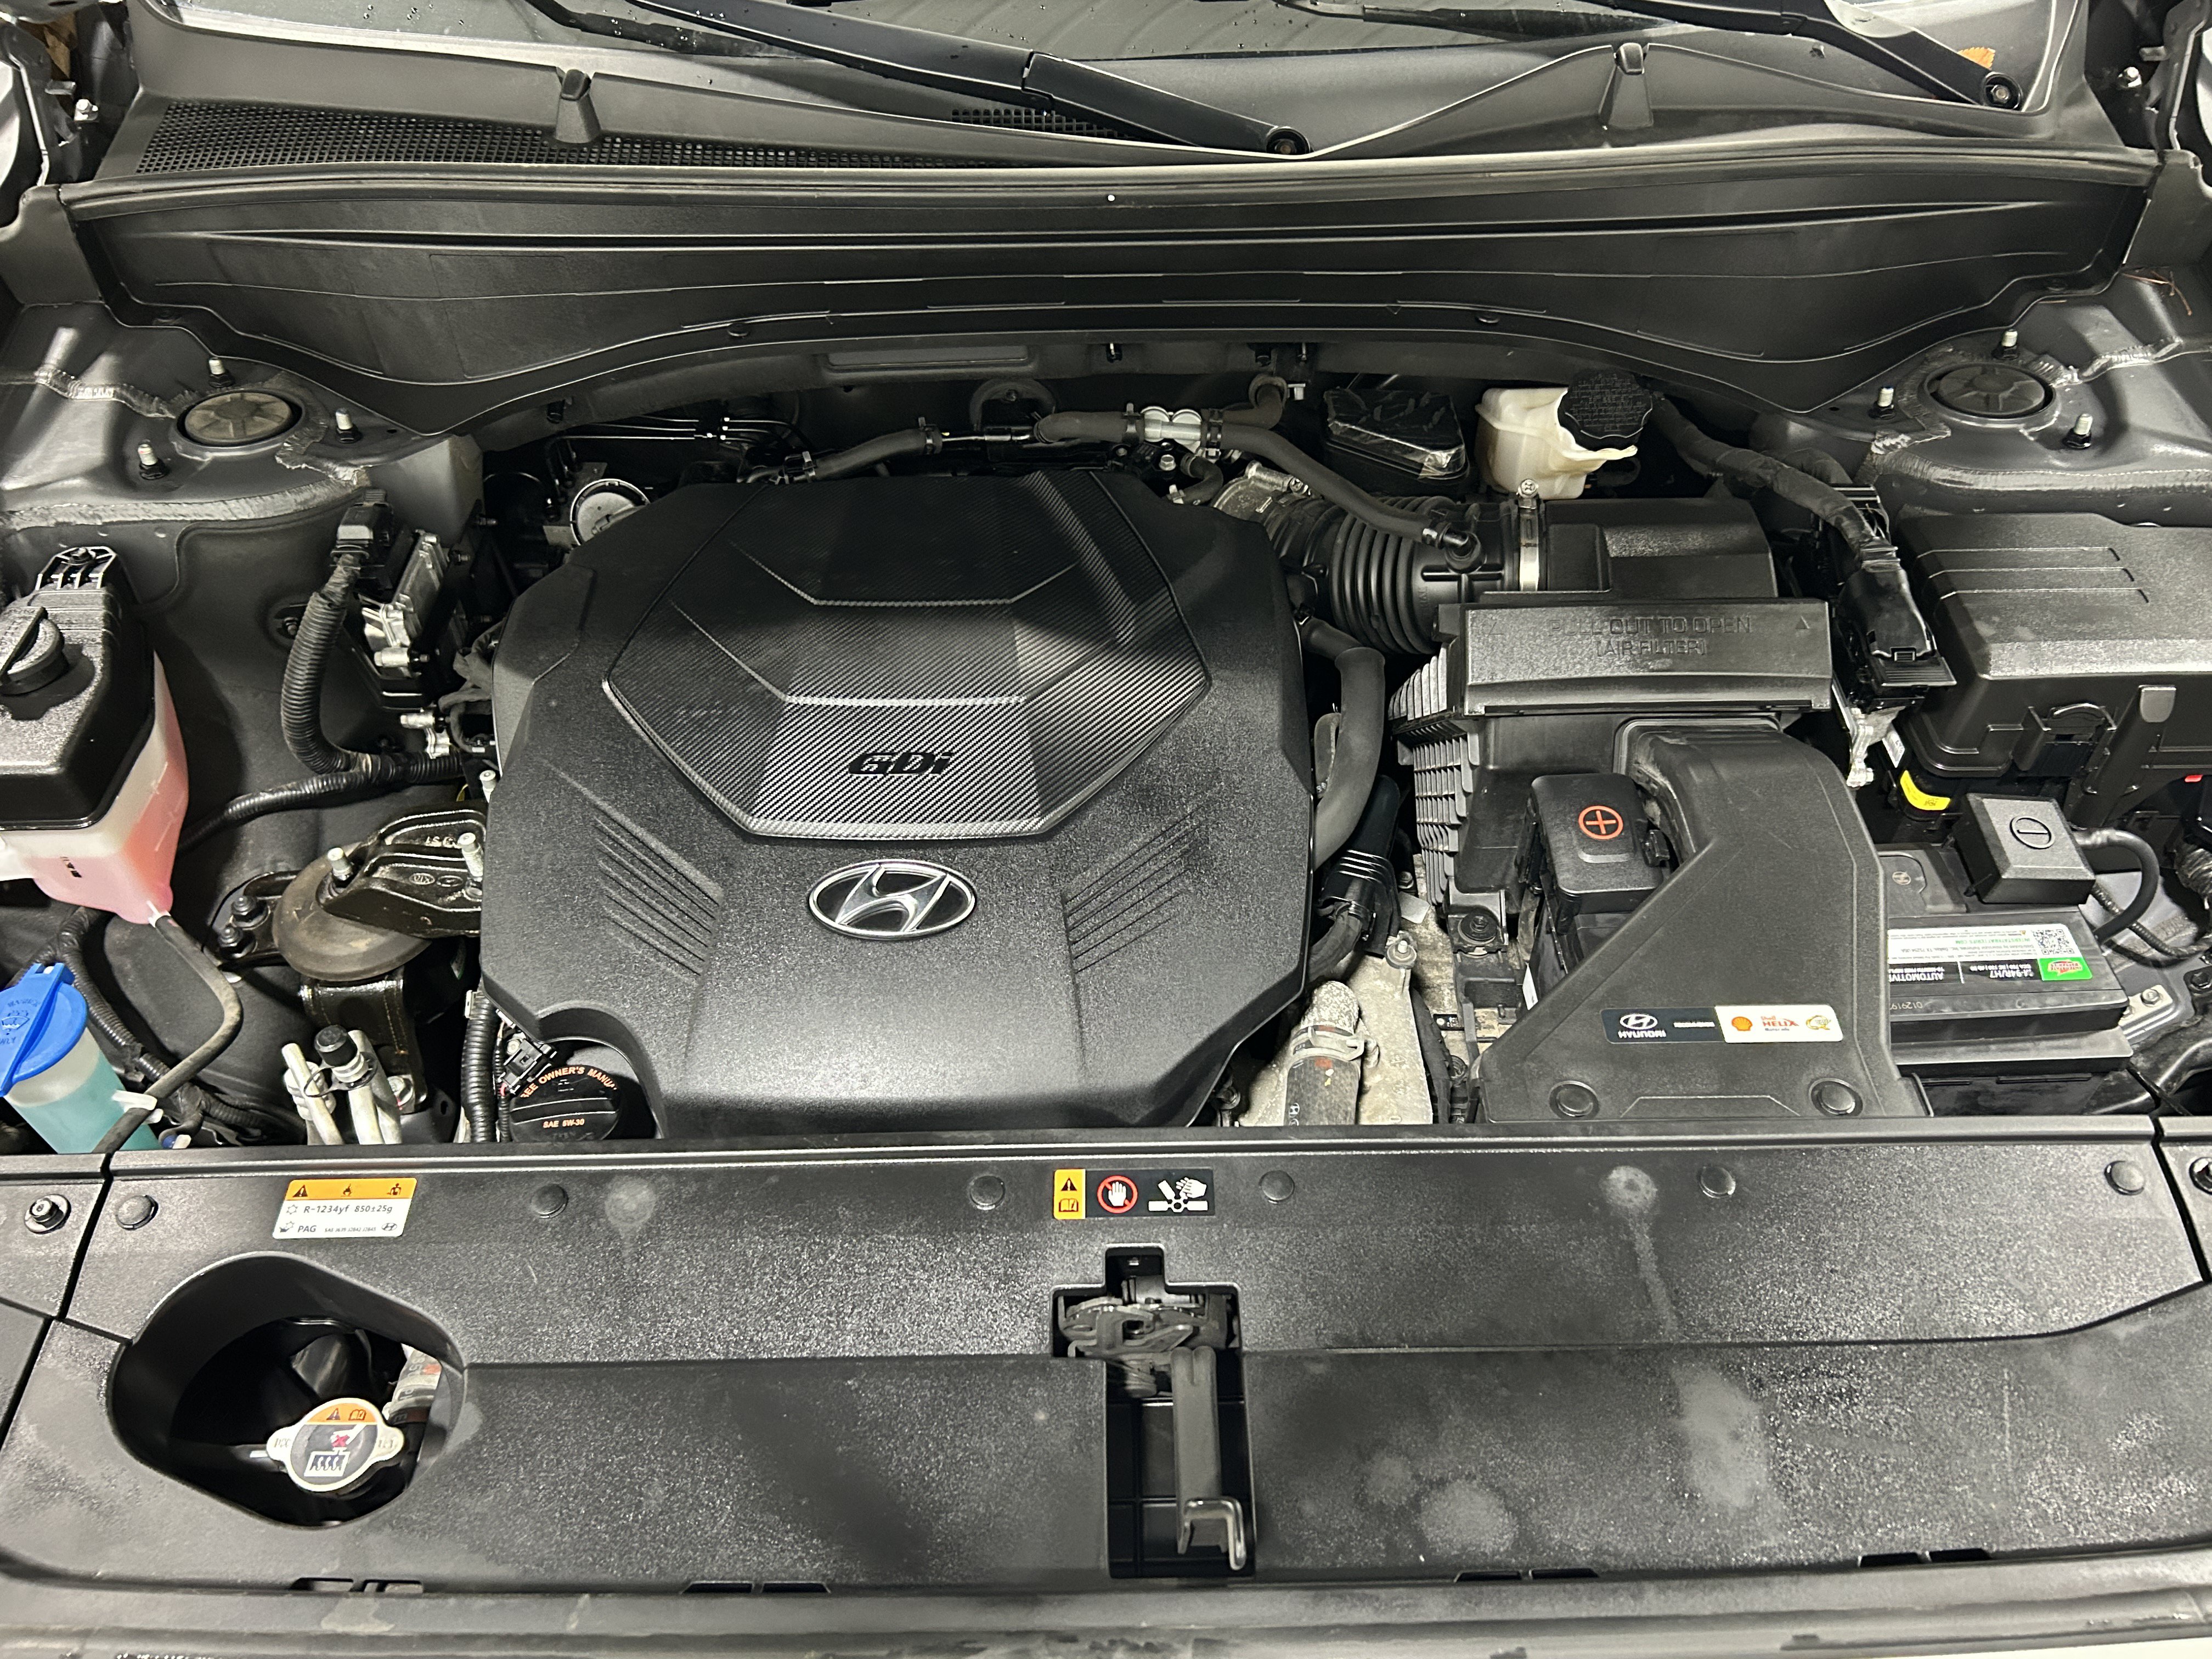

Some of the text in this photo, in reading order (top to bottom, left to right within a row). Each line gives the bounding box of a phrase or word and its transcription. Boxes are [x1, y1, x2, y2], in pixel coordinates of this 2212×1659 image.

[1548, 615, 1752, 636] PULL OUT TO OPEN
[848, 752, 954, 775] GDi
[1618, 1030, 1666, 1039] HYUNDAI
[520, 1083, 539, 1098] SEE
[538, 1066, 585, 1084] OWNER'S
[543, 1119, 585, 1128] SAE 5W-30
[303, 1205, 393, 1214] R-1234yf 850±25g
